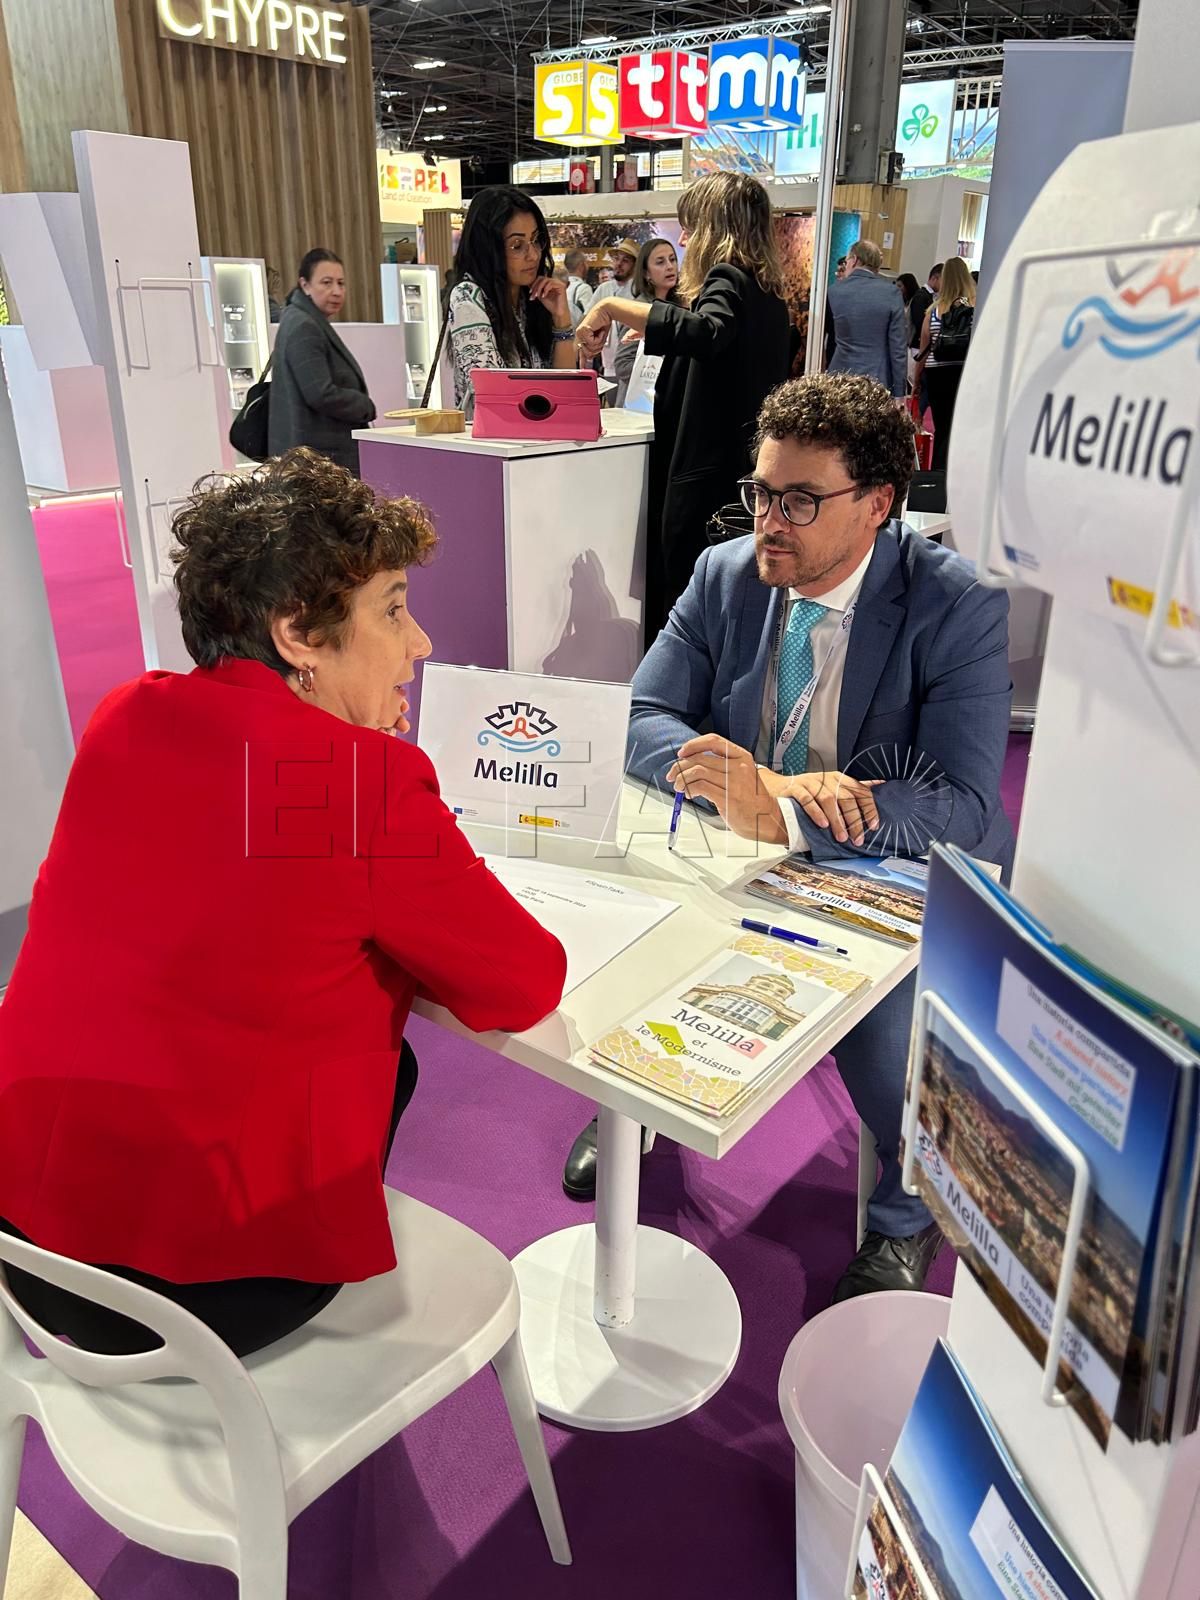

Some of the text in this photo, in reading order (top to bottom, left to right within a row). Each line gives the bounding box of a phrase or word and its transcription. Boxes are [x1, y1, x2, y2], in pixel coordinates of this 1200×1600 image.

[157, 0, 347, 64] CHYPRE
[1029, 392, 1194, 486] Melilla
[789, 703, 805, 728] Melilla
[473, 758, 559, 789] Melilla
[806, 889, 852, 909] Melilla
[634, 1024, 743, 1077] le Modernisme
[671, 1008, 756, 1053] Melilla
[691, 1038, 708, 1049] et
[945, 1181, 1000, 1266] Melilla
